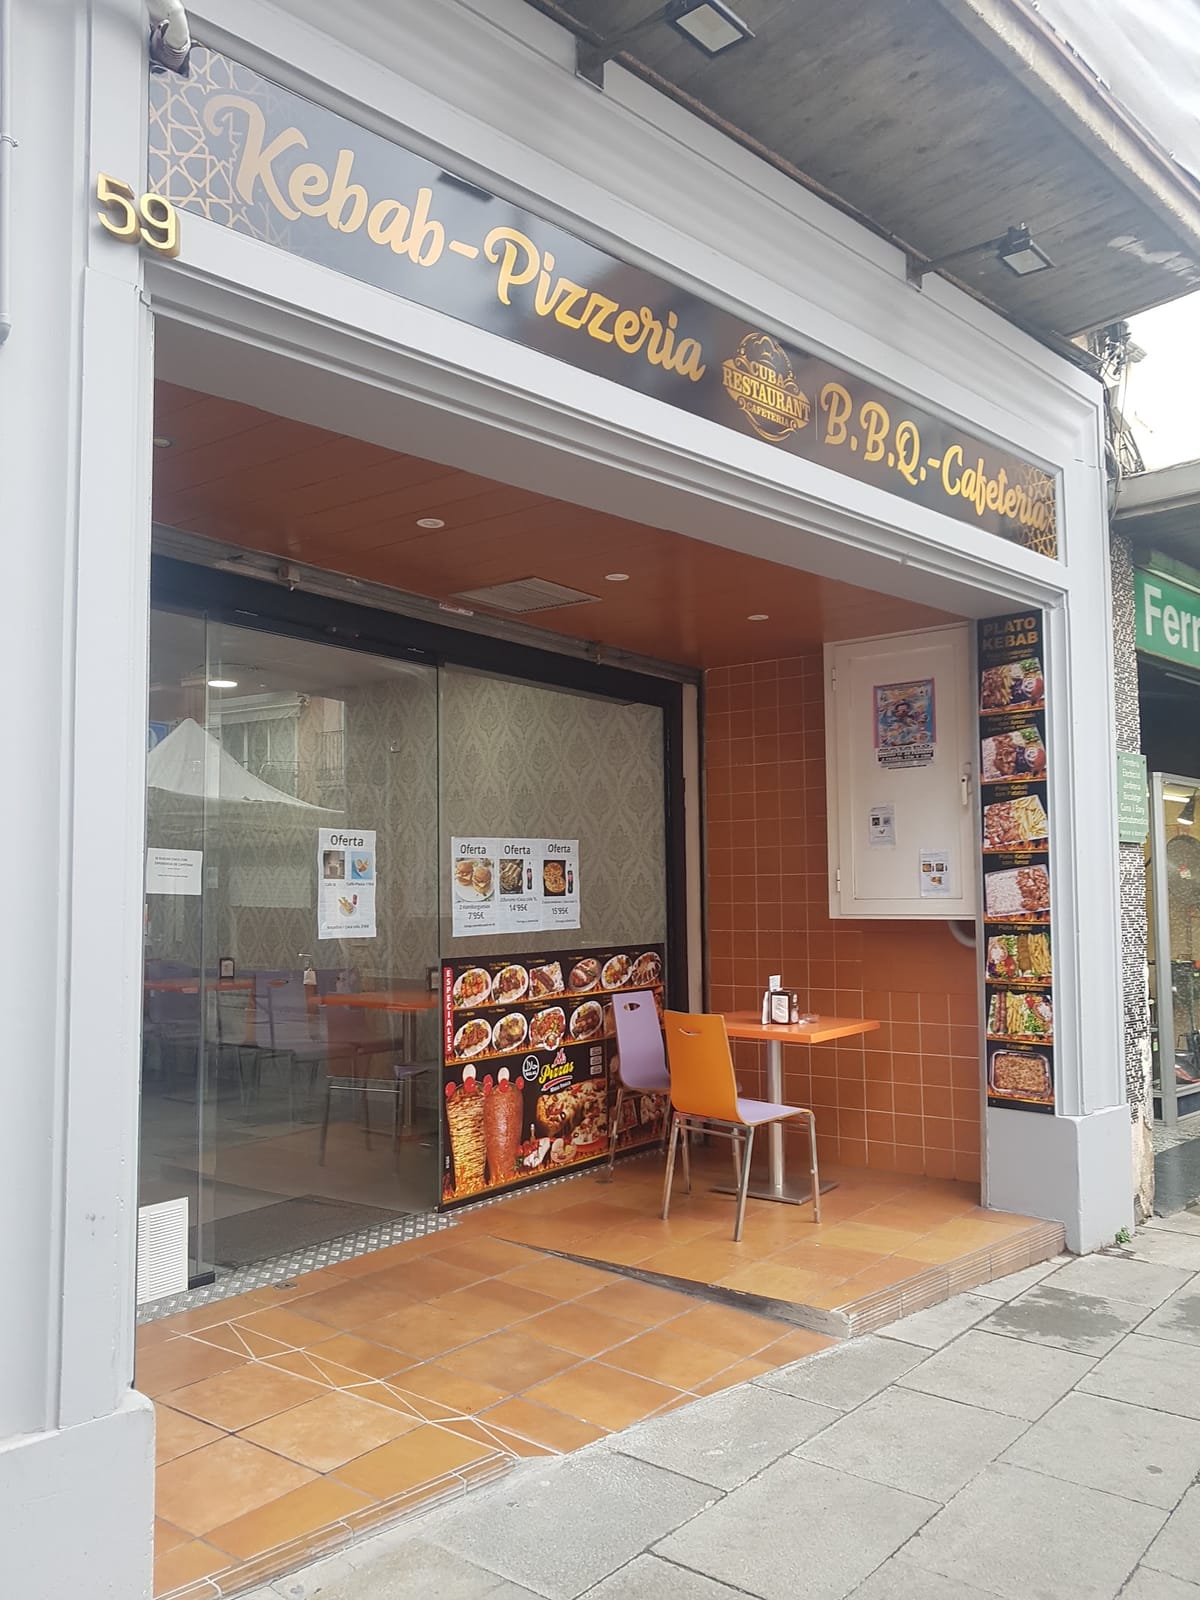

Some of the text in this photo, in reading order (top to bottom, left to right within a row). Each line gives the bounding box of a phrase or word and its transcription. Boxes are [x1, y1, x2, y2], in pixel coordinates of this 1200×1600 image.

[96, 173, 181, 258] 59
[750, 361, 785, 387] CUBA
[722, 365, 811, 422] RESTAURANT
[746, 402, 790, 428] CAFETERIA
[983, 617, 1036, 637] PLATO
[982, 632, 1039, 651] KEBAB
[330, 834, 365, 848] Oferta
[460, 844, 487, 855] Oferta
[504, 845, 531, 855] Oferta
[547, 843, 571, 854] Oferta
[538, 1061, 575, 1084] Pizzas
